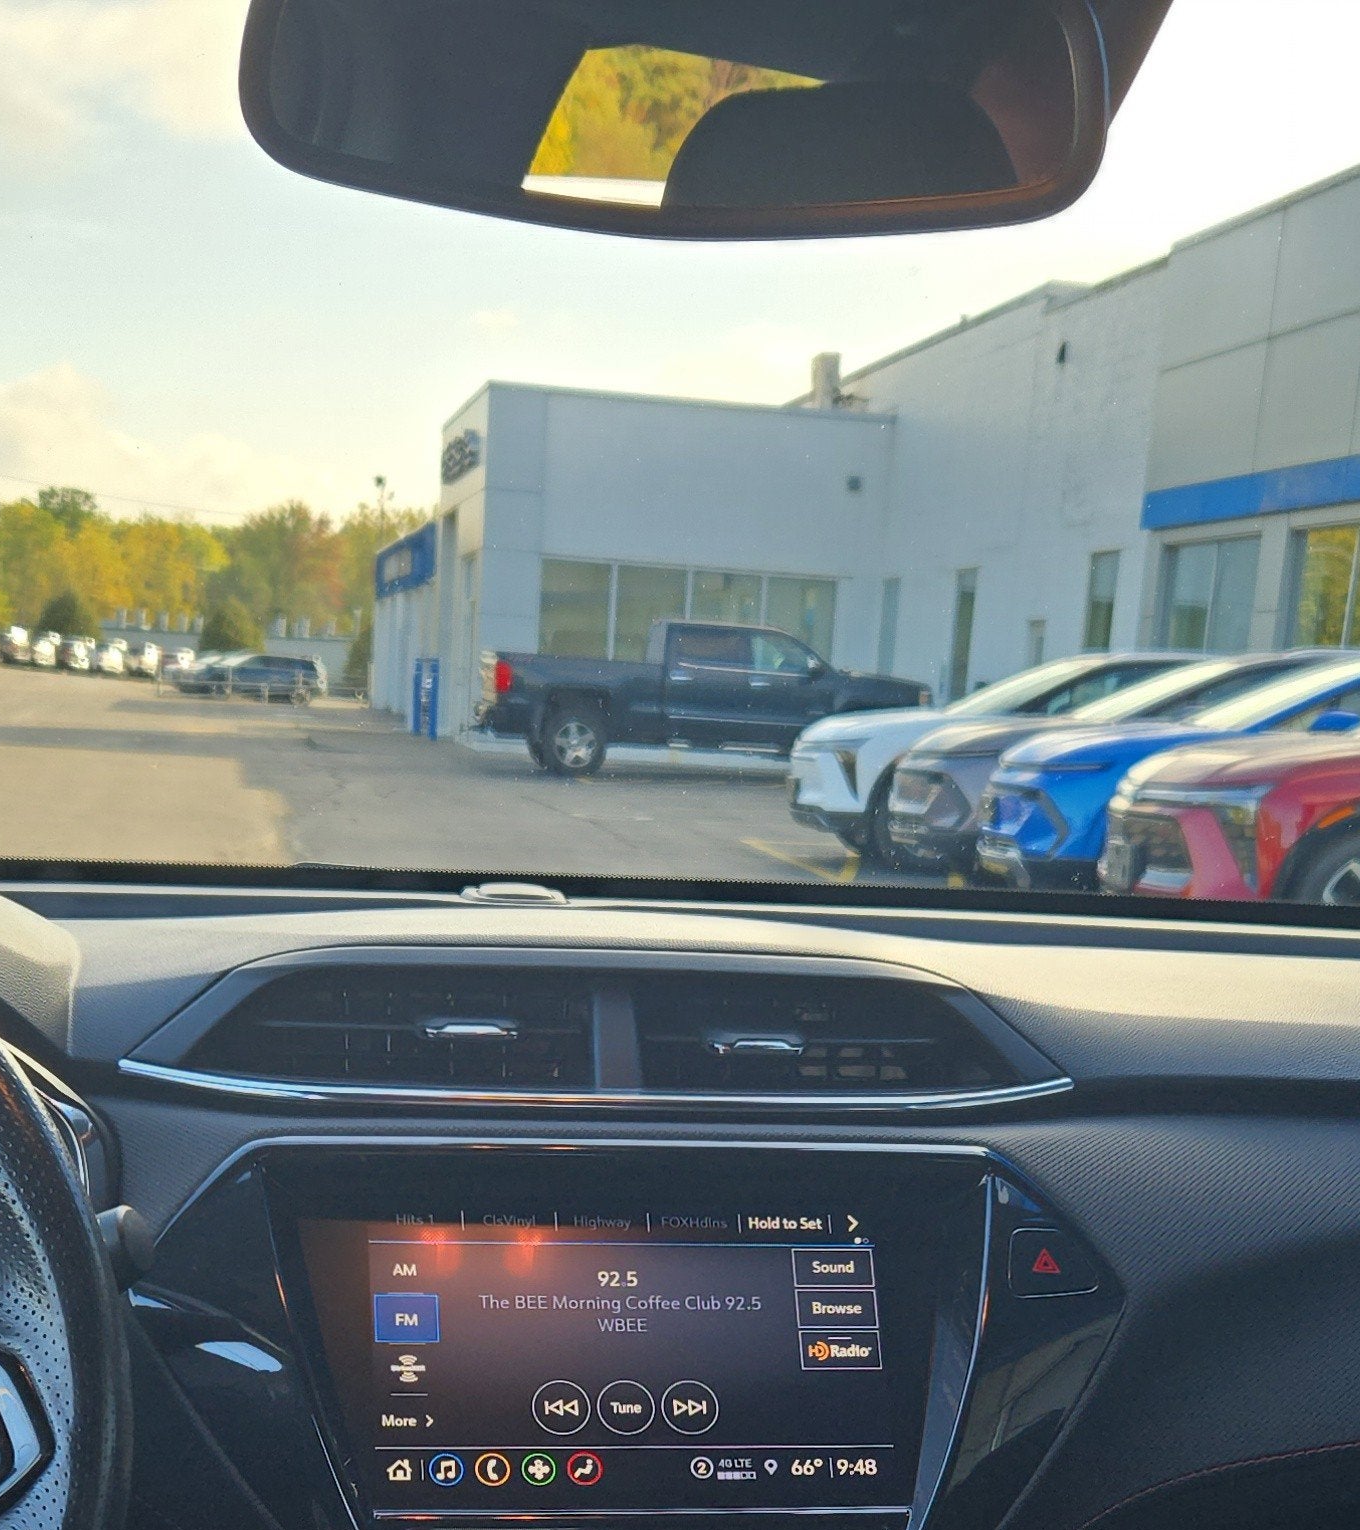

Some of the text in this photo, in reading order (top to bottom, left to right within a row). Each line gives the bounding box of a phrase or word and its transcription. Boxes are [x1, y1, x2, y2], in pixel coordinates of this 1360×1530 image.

[573, 1215, 632, 1231] Highway
[748, 1216, 823, 1231] Hold to Set
[392, 1263, 418, 1277] AM
[811, 1260, 855, 1274] Sound
[596, 1270, 638, 1287] 92.5
[478, 1295, 762, 1314] The BEE Morning Coffee Club 92.5
[811, 1301, 862, 1315] Browse
[394, 1312, 419, 1327] FM
[596, 1317, 648, 1332] WBEE
[609, 1400, 642, 1414] Tune
[380, 1414, 418, 1428] More
[717, 1458, 753, 1469] 4G LTE
[836, 1458, 879, 1477] 9:48
